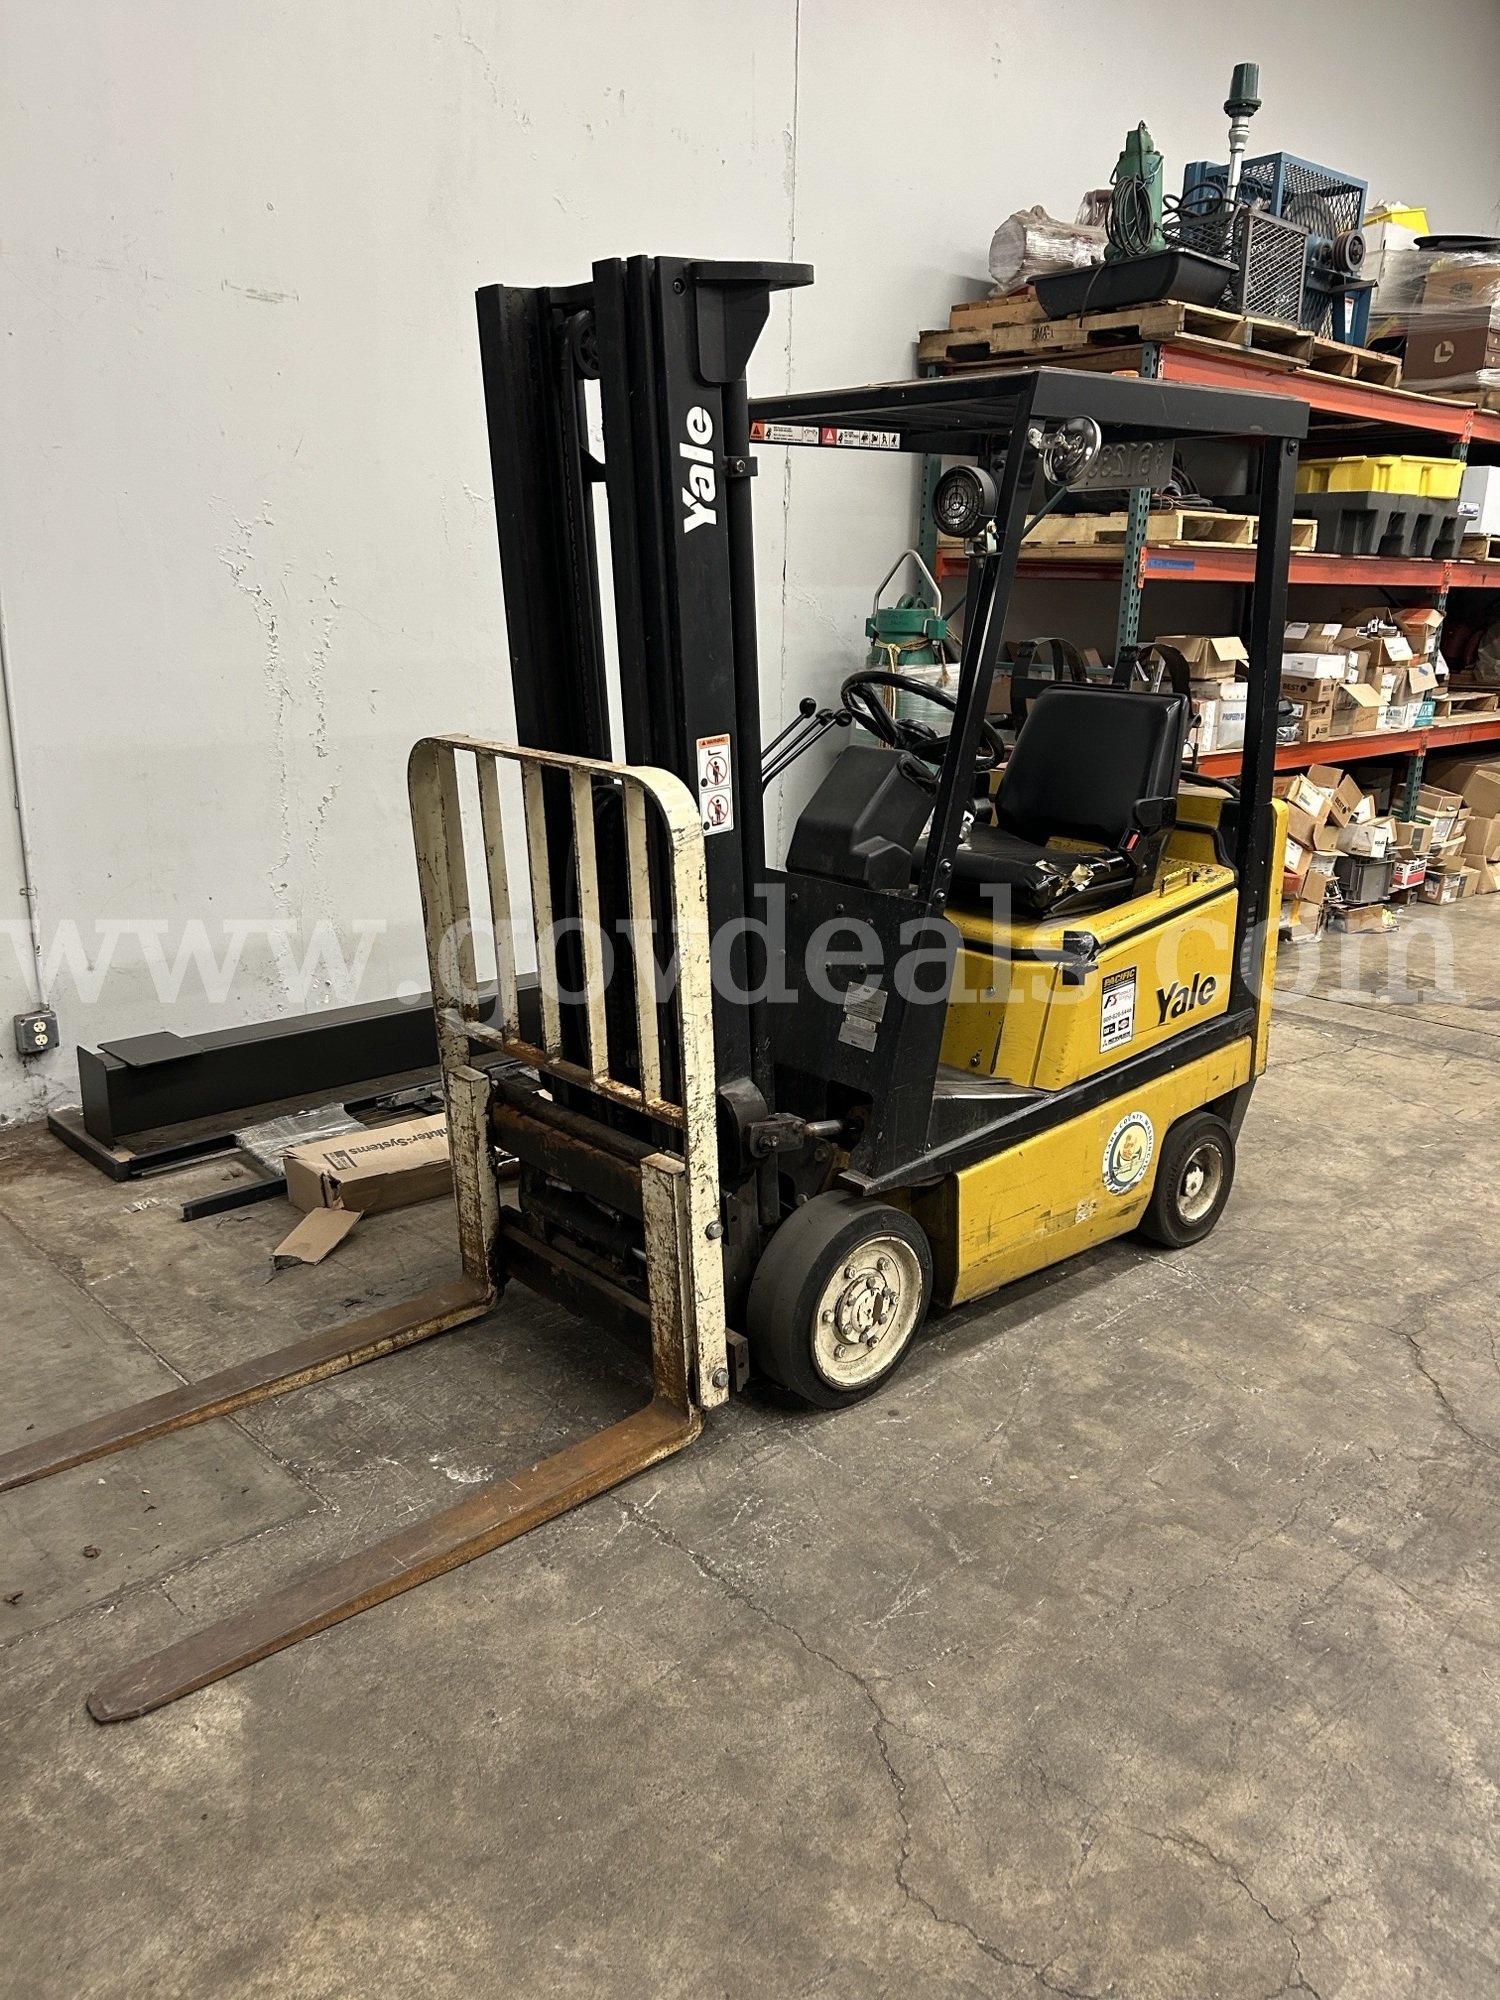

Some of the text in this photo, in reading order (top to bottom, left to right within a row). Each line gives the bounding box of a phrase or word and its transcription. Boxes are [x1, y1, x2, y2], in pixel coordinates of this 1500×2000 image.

[680, 406, 717, 533] Yale
[1104, 969, 1135, 987] PACIFIC
[1156, 971, 1217, 1025] Yale
[1104, 1131, 1118, 1162] CLARK
